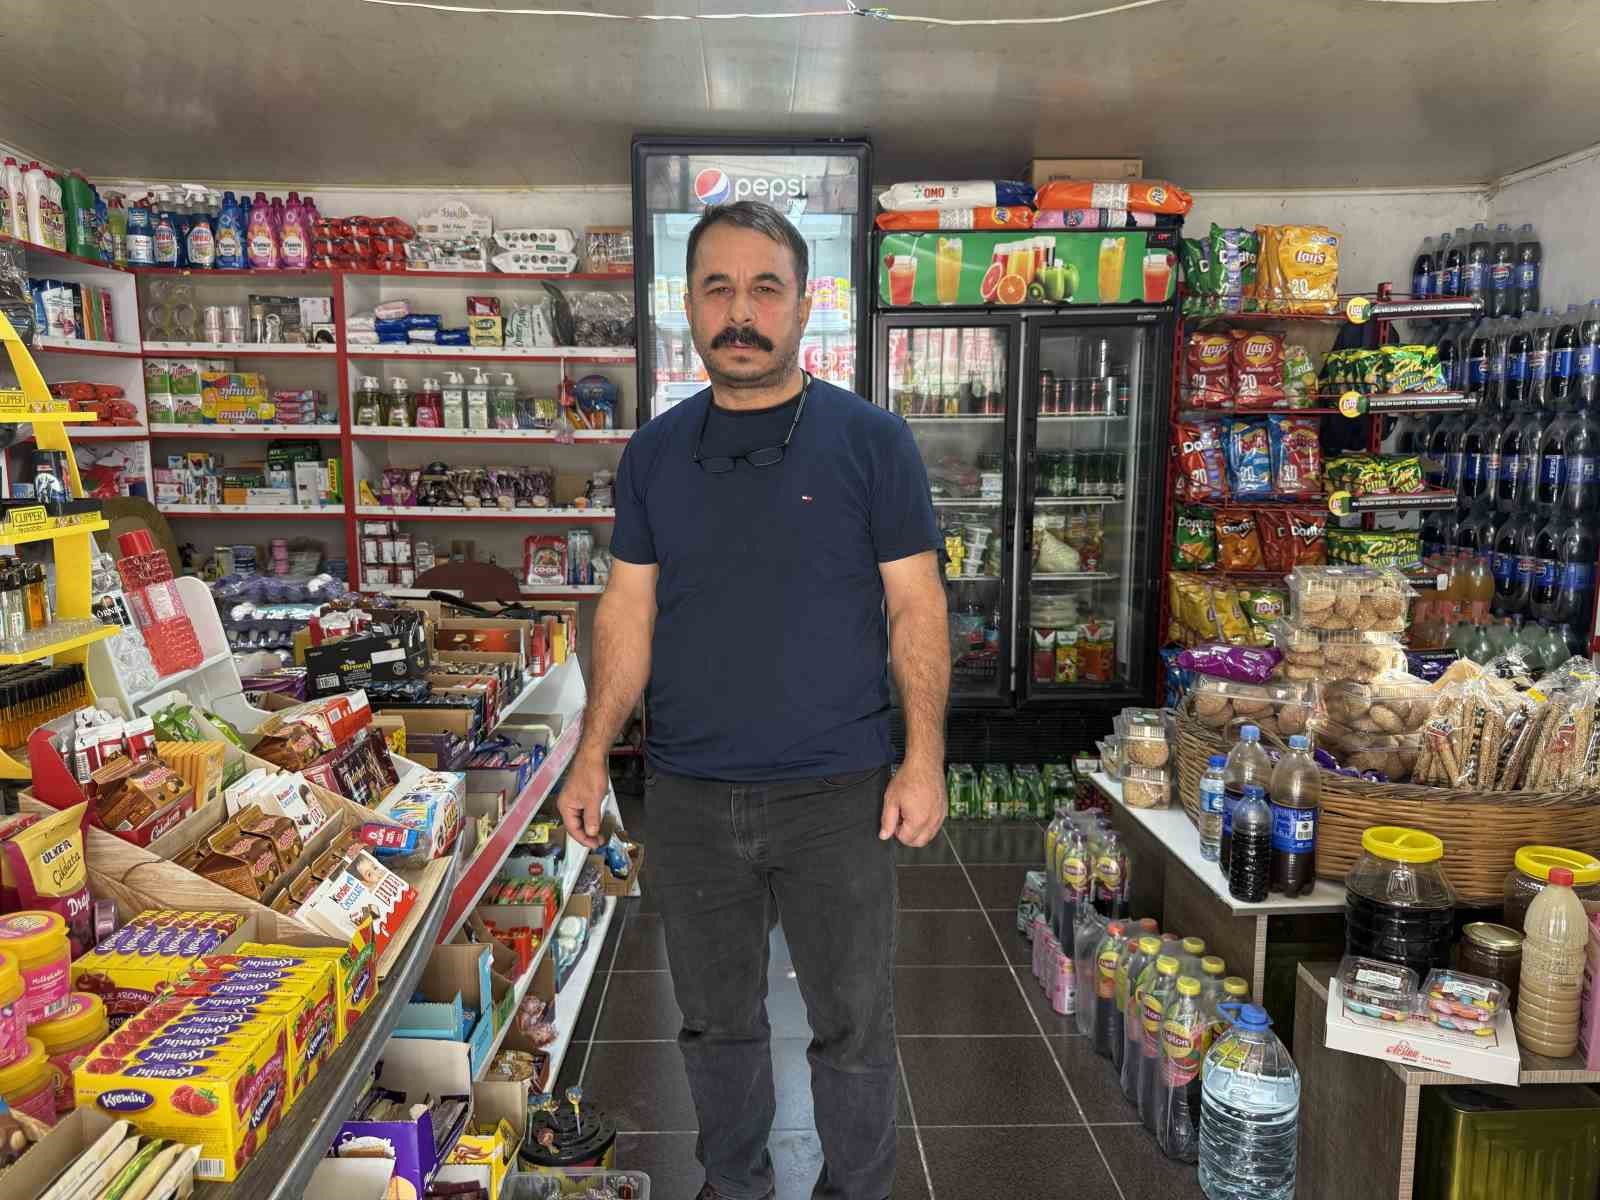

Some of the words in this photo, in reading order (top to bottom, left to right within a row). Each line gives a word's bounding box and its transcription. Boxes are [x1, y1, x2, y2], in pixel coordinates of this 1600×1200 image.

[735, 174, 806, 201] pepsi
[924, 187, 945, 199] OMO
[1291, 278, 1309, 294] 20
[1239, 374, 1257, 390] 20
[14, 510, 44, 524] CLIPPER
[41, 839, 73, 865] ÜLKER
[52, 851, 82, 888] Çikolata
[134, 1064, 194, 1078] Kremini
[102, 1090, 147, 1108] Kremini
